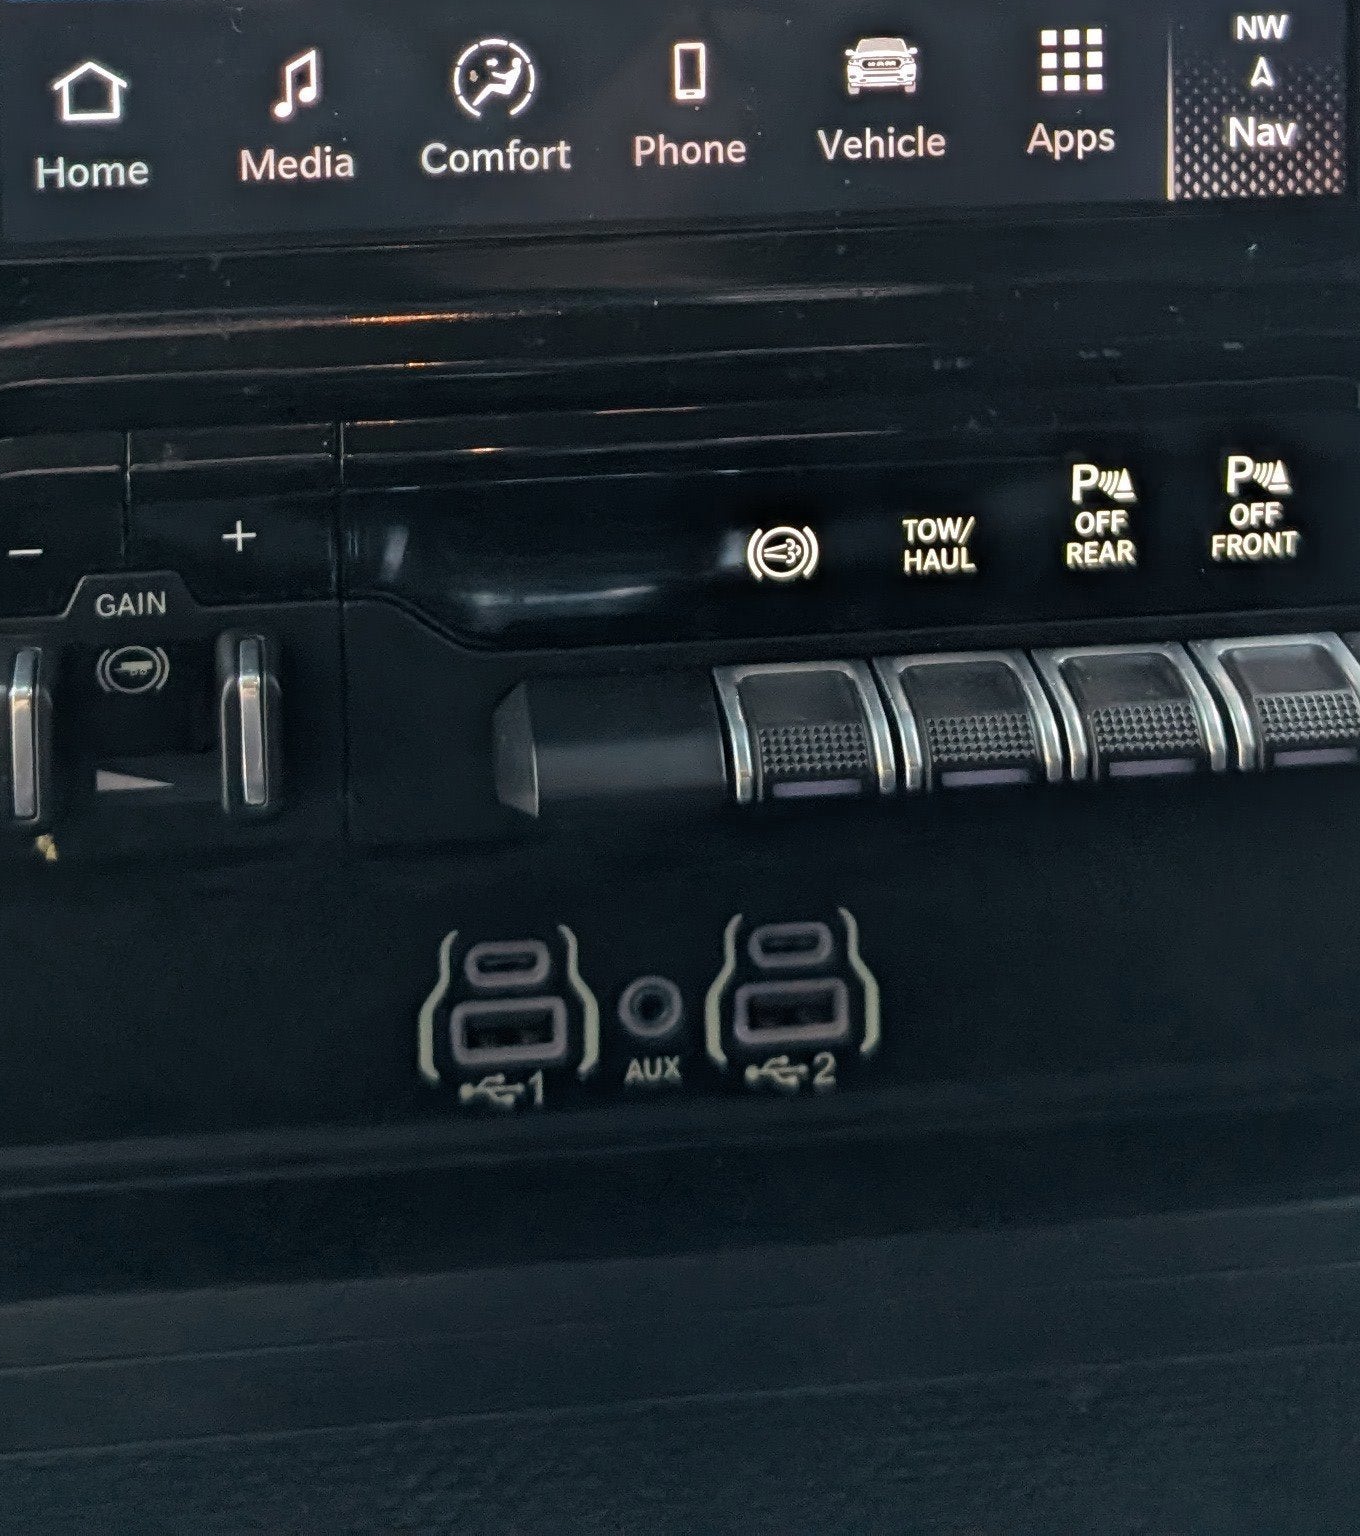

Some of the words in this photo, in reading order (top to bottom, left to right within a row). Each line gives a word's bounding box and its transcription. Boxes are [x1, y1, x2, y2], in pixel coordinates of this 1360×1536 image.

[1236, 14, 1289, 41] NW
[818, 125, 947, 161] Vehicle
[1026, 123, 1116, 159] Apps
[1228, 117, 1296, 148] Nav
[240, 147, 356, 182] Media
[420, 139, 573, 175] Comfort
[634, 133, 748, 166] Phone
[36, 156, 150, 189] Home
[1074, 509, 1129, 536] OFF
[1228, 501, 1283, 528] OFF
[902, 516, 976, 546] TOW/
[1211, 530, 1300, 560] FRONT
[903, 548, 977, 575] HAUL
[1066, 540, 1137, 570] REAR
[95, 591, 167, 618] GAIN
[624, 1056, 682, 1085] AUX
[814, 1052, 837, 1086] 2
